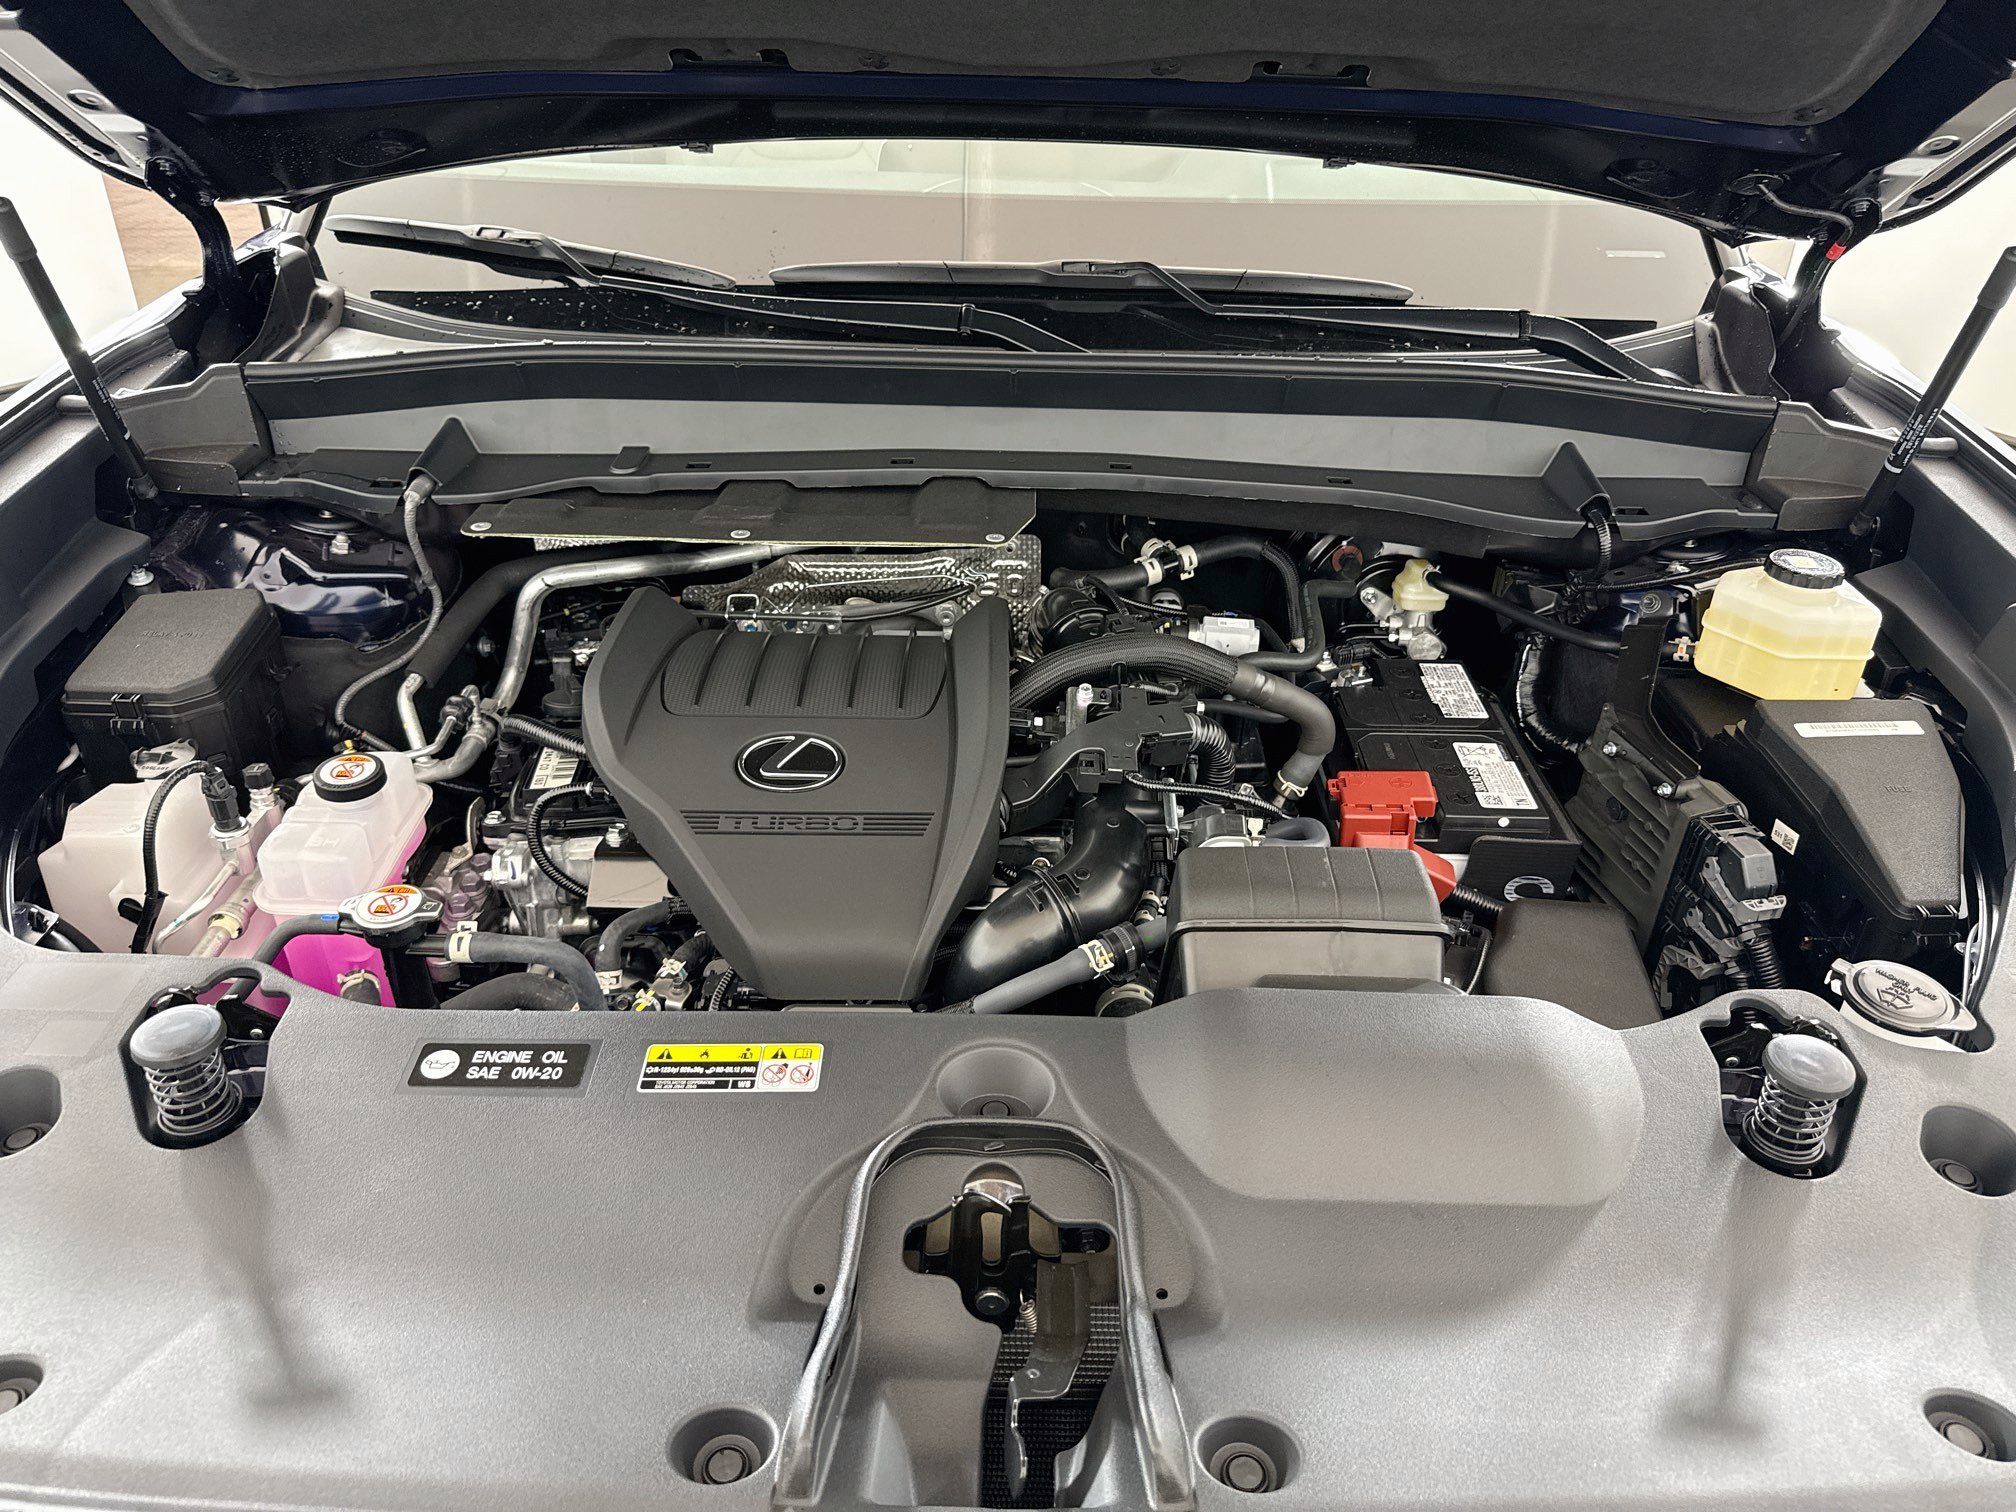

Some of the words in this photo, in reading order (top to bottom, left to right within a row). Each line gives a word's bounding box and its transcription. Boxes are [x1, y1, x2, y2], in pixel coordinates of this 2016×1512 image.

[723, 815, 860, 831] TURBO
[471, 1050, 534, 1064] ENGINE
[541, 1050, 569, 1064] OIL
[465, 1066, 502, 1080] SAE
[511, 1066, 563, 1080] 0W-20
